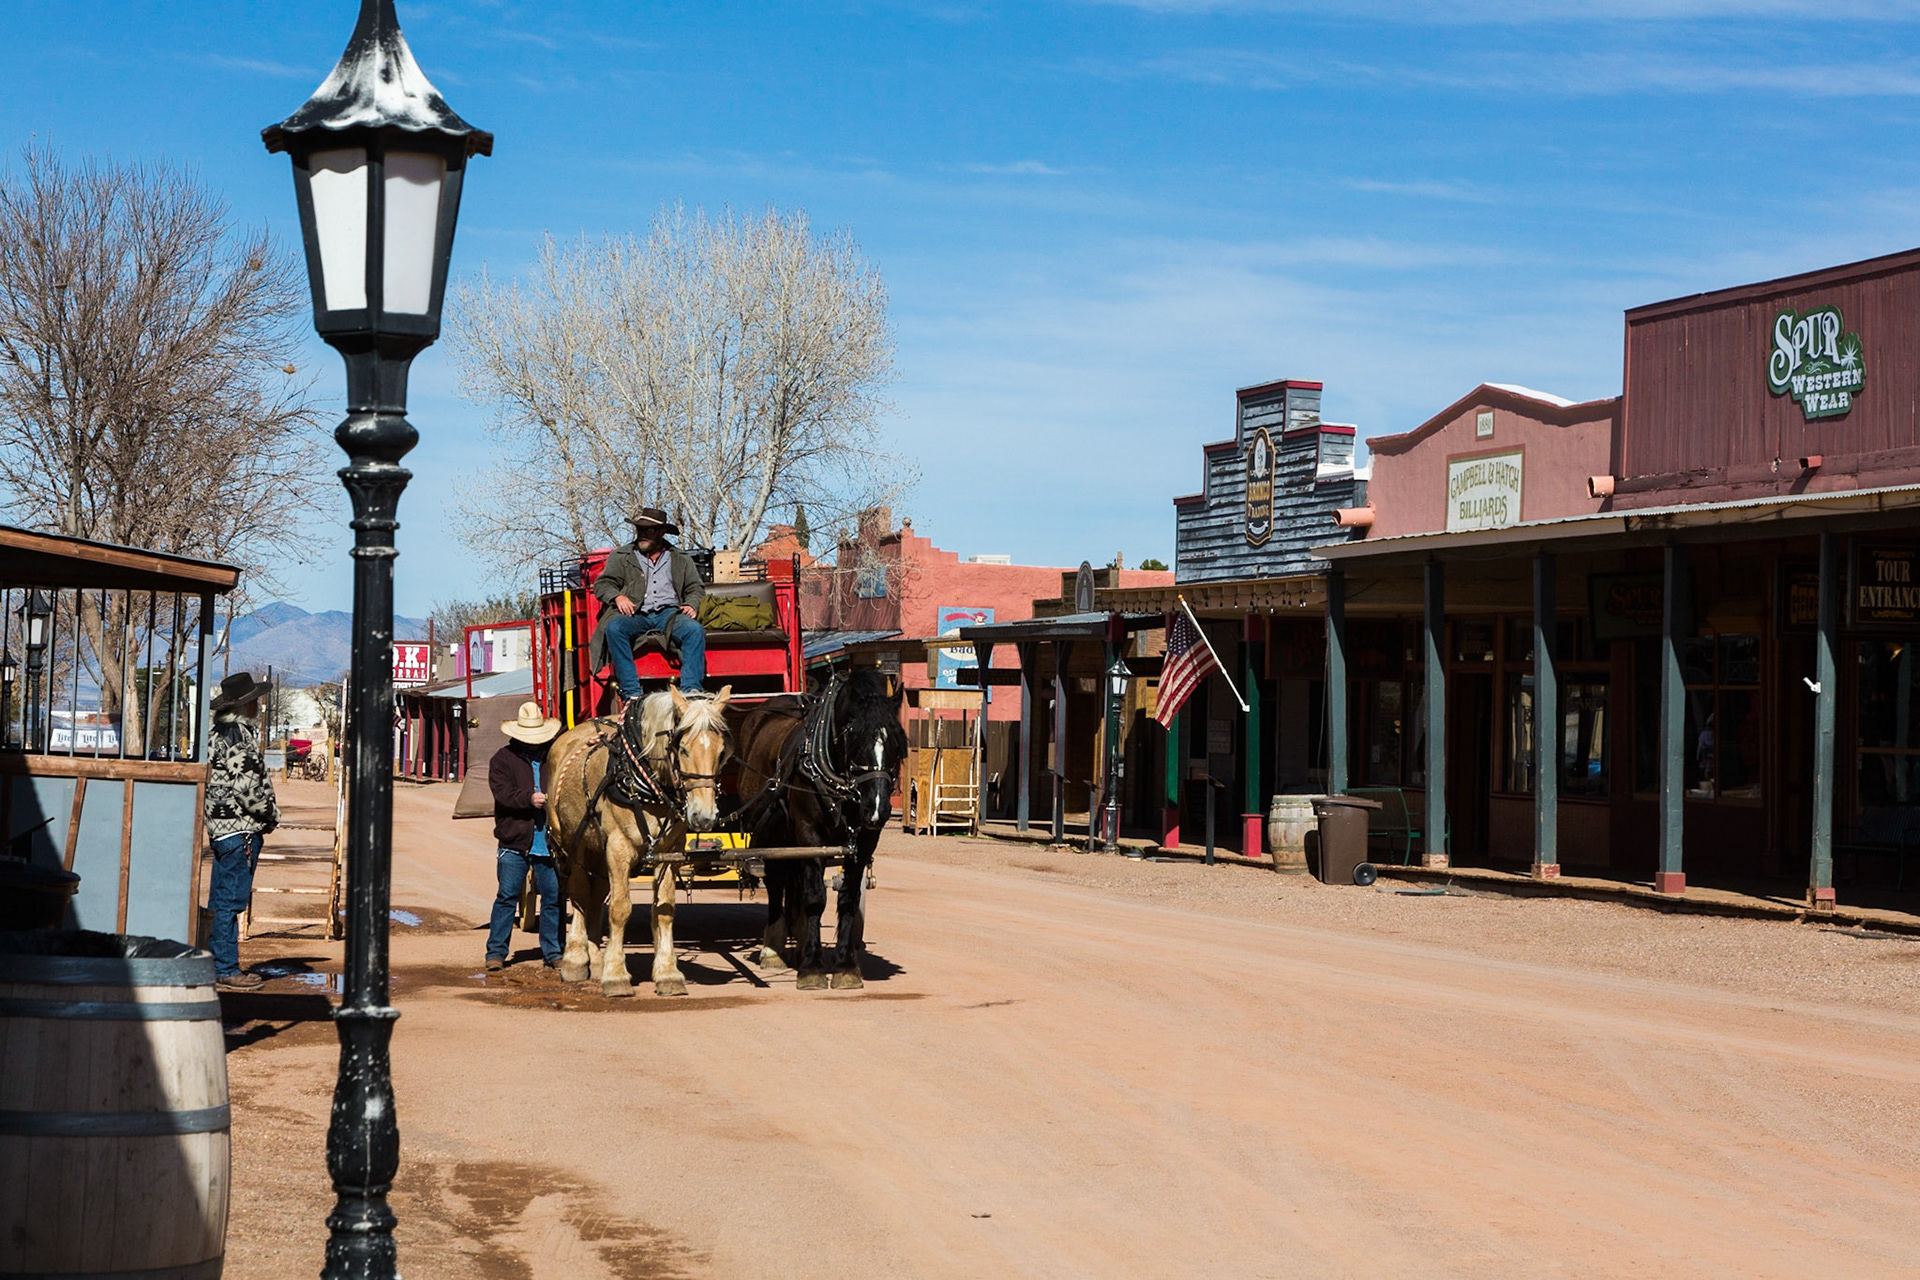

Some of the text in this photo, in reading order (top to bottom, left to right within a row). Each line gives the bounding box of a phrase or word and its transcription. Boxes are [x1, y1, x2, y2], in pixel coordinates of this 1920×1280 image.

[1770, 311, 1841, 386] SPUR
[1791, 368, 1862, 394] WESTERN
[1804, 392, 1850, 413] WEAR
[1450, 461, 1520, 503] CAMPBELL & HATCH
[1459, 495, 1508, 527] BILLIARDS
[1875, 560, 1911, 583] TOUR
